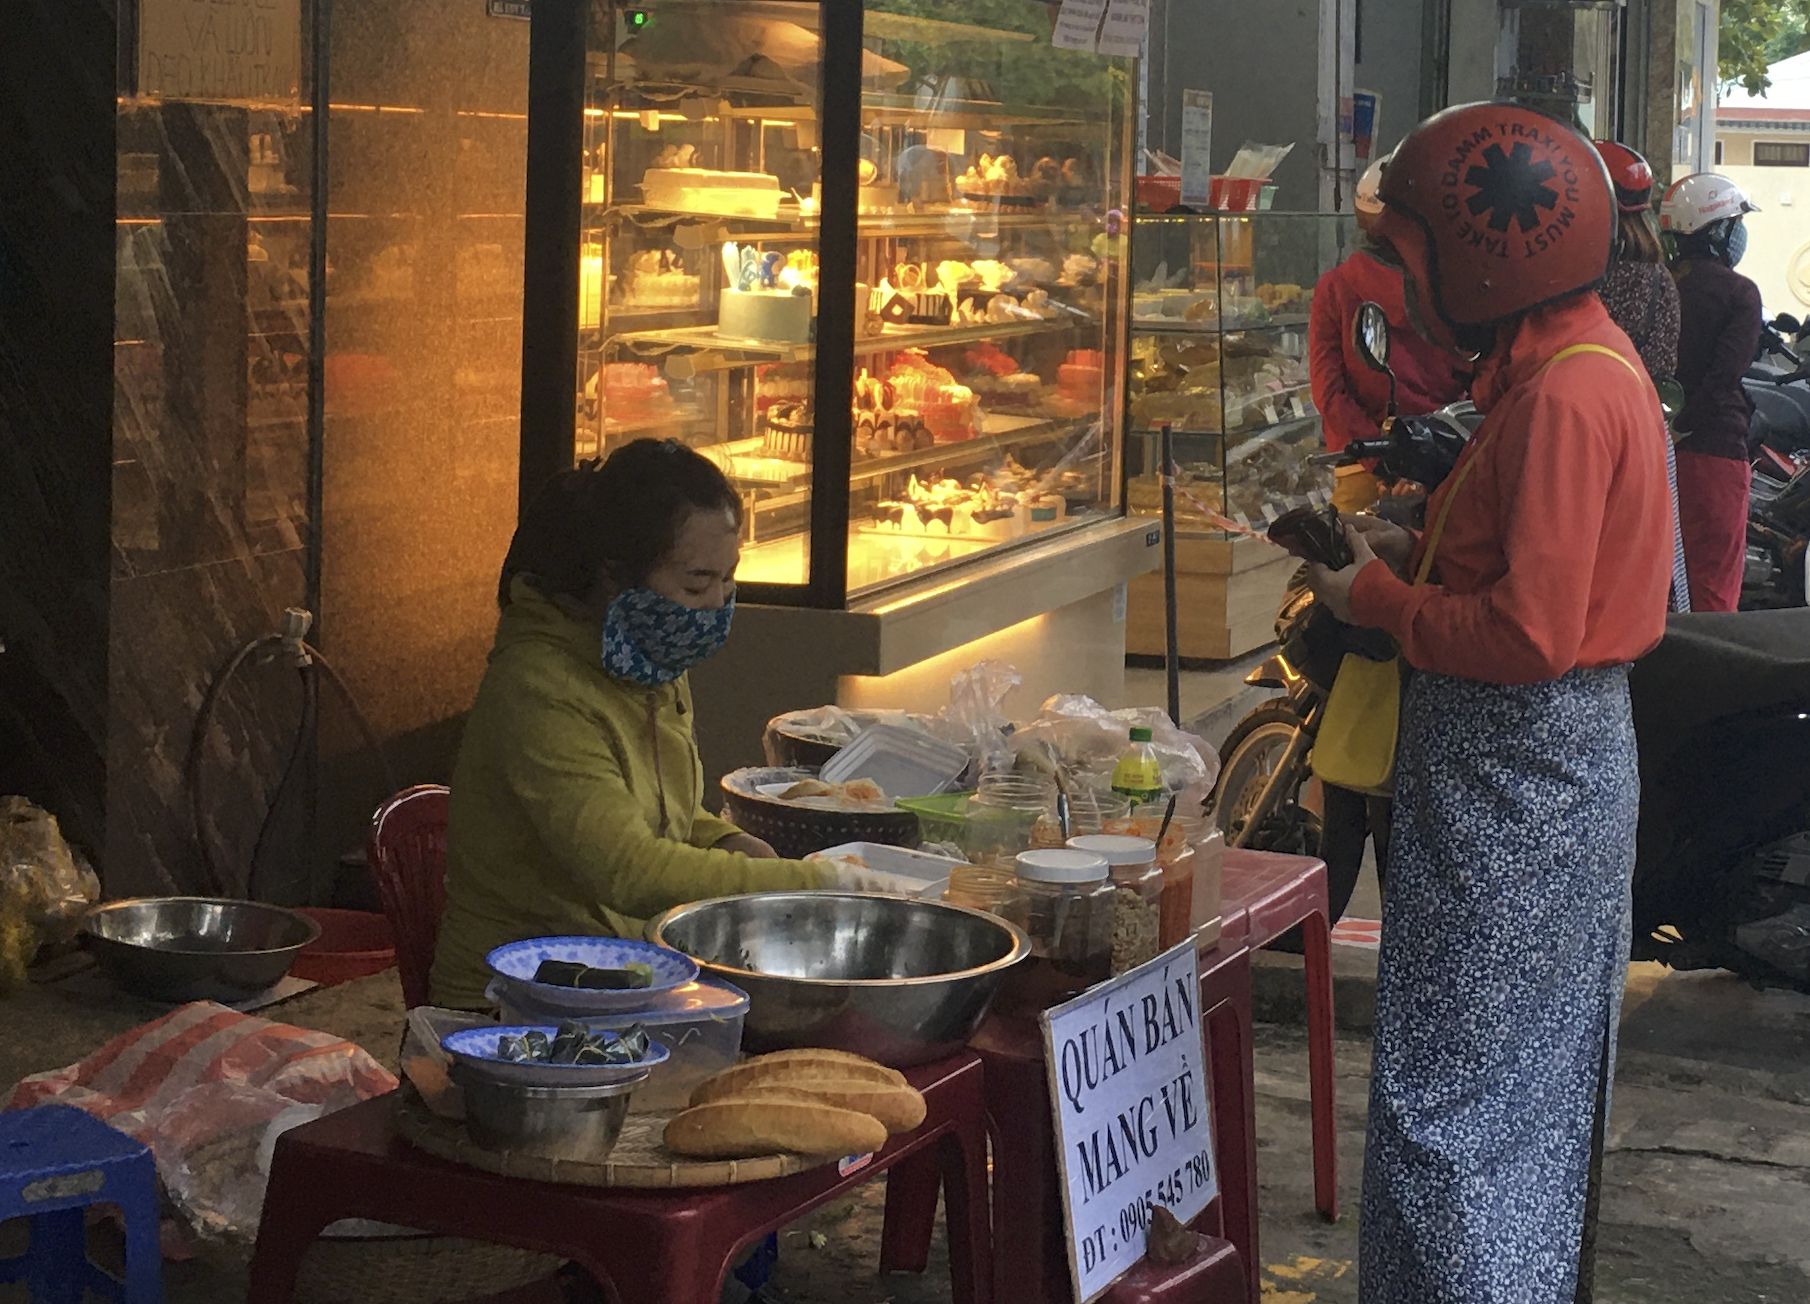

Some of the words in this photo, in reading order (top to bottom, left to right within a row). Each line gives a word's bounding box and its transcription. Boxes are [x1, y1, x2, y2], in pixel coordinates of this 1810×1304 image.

[1558, 155, 1580, 203] YOU
[1442, 193, 1462, 221] TO
[1525, 206, 1576, 259] MUST
[1456, 222, 1510, 258] TAKE
[1061, 997, 1138, 1114] QUÁN
[1142, 966, 1195, 1057] BÁN
[1076, 1095, 1160, 1205] MANG
[1161, 1053, 1198, 1141] VỀ
[1120, 1188, 1154, 1244] 0905
[1184, 1149, 1211, 1194] 780
